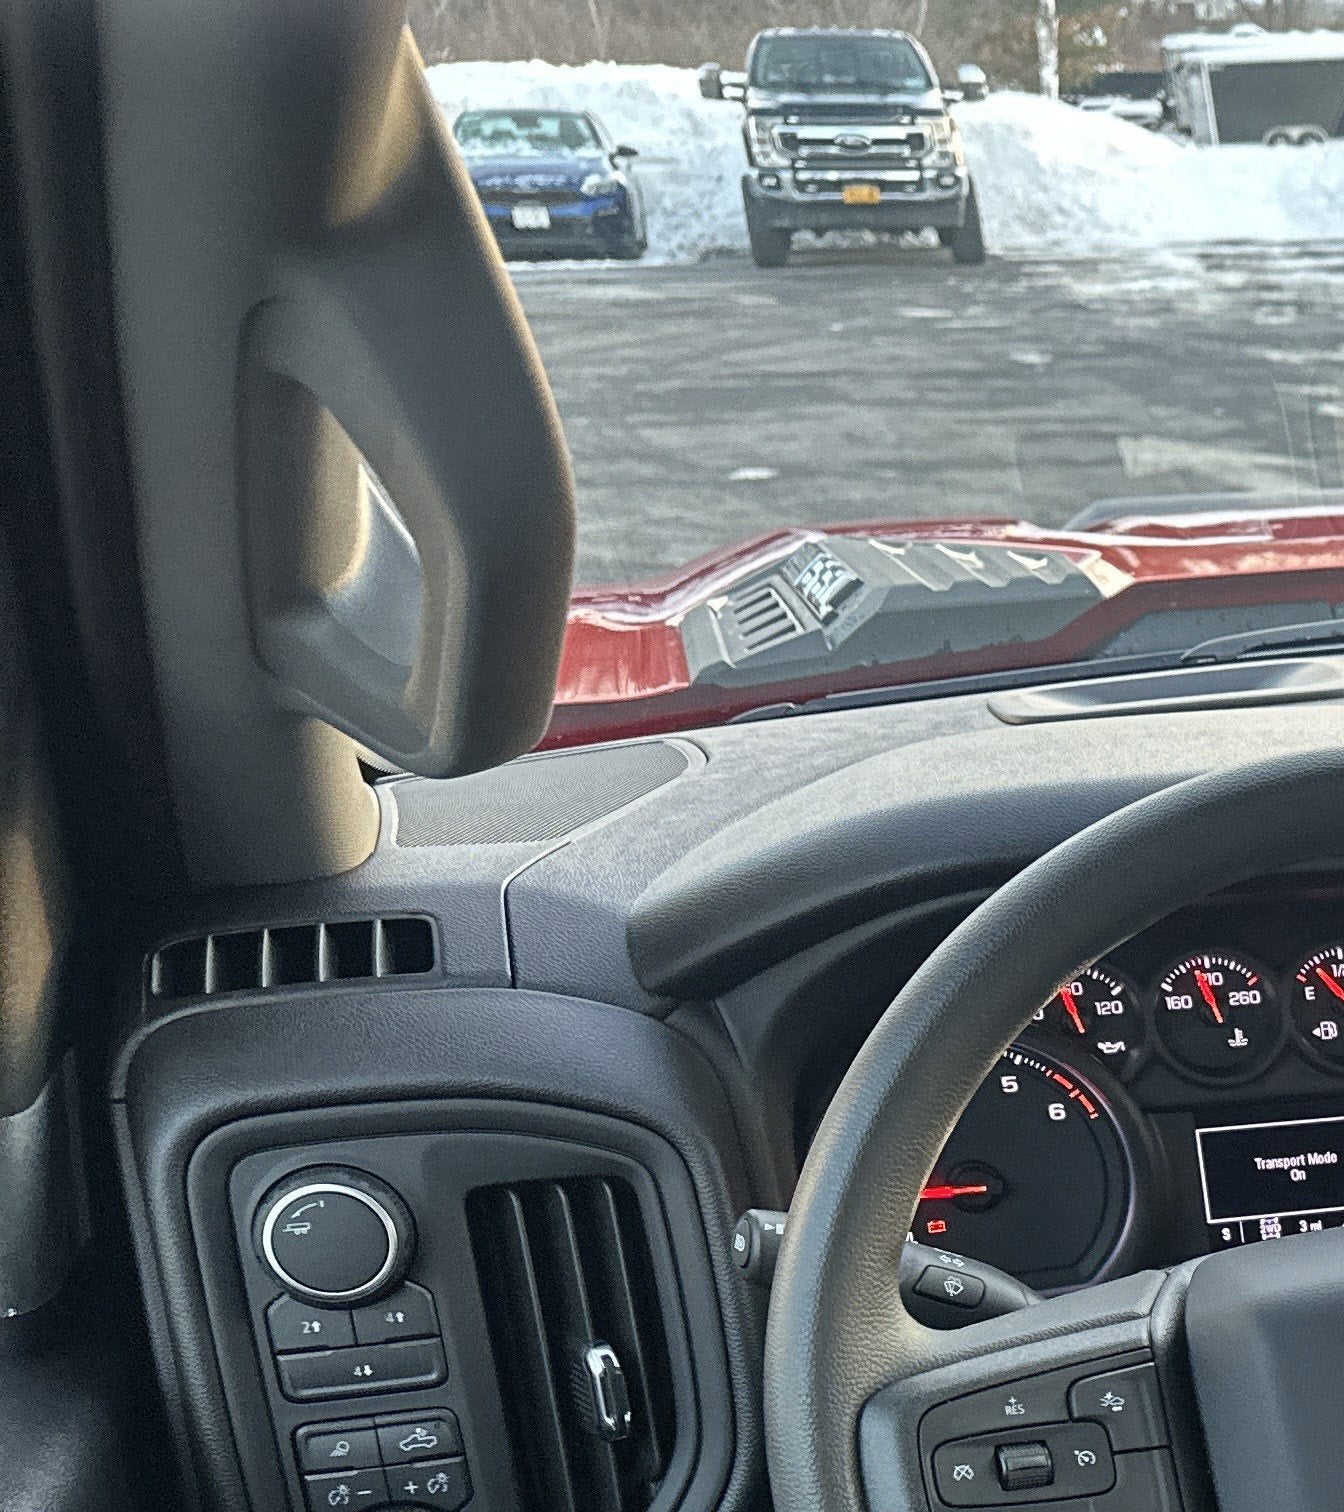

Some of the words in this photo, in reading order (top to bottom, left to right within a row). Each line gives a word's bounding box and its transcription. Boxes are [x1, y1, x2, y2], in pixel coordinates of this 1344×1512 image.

[1229, 990, 1261, 1005] 260
[1304, 986, 1316, 1001] E
[1095, 1001, 1123, 1015] 120
[1165, 995, 1192, 1010] 160
[1001, 1076, 1018, 1093] 5
[1048, 1103, 1066, 1120] 6
[1254, 1154, 1305, 1170] Transport
[1307, 1151, 1338, 1165] Mode
[1290, 1169, 1306, 1181] On
[1004, 1403, 1025, 1416] RES
